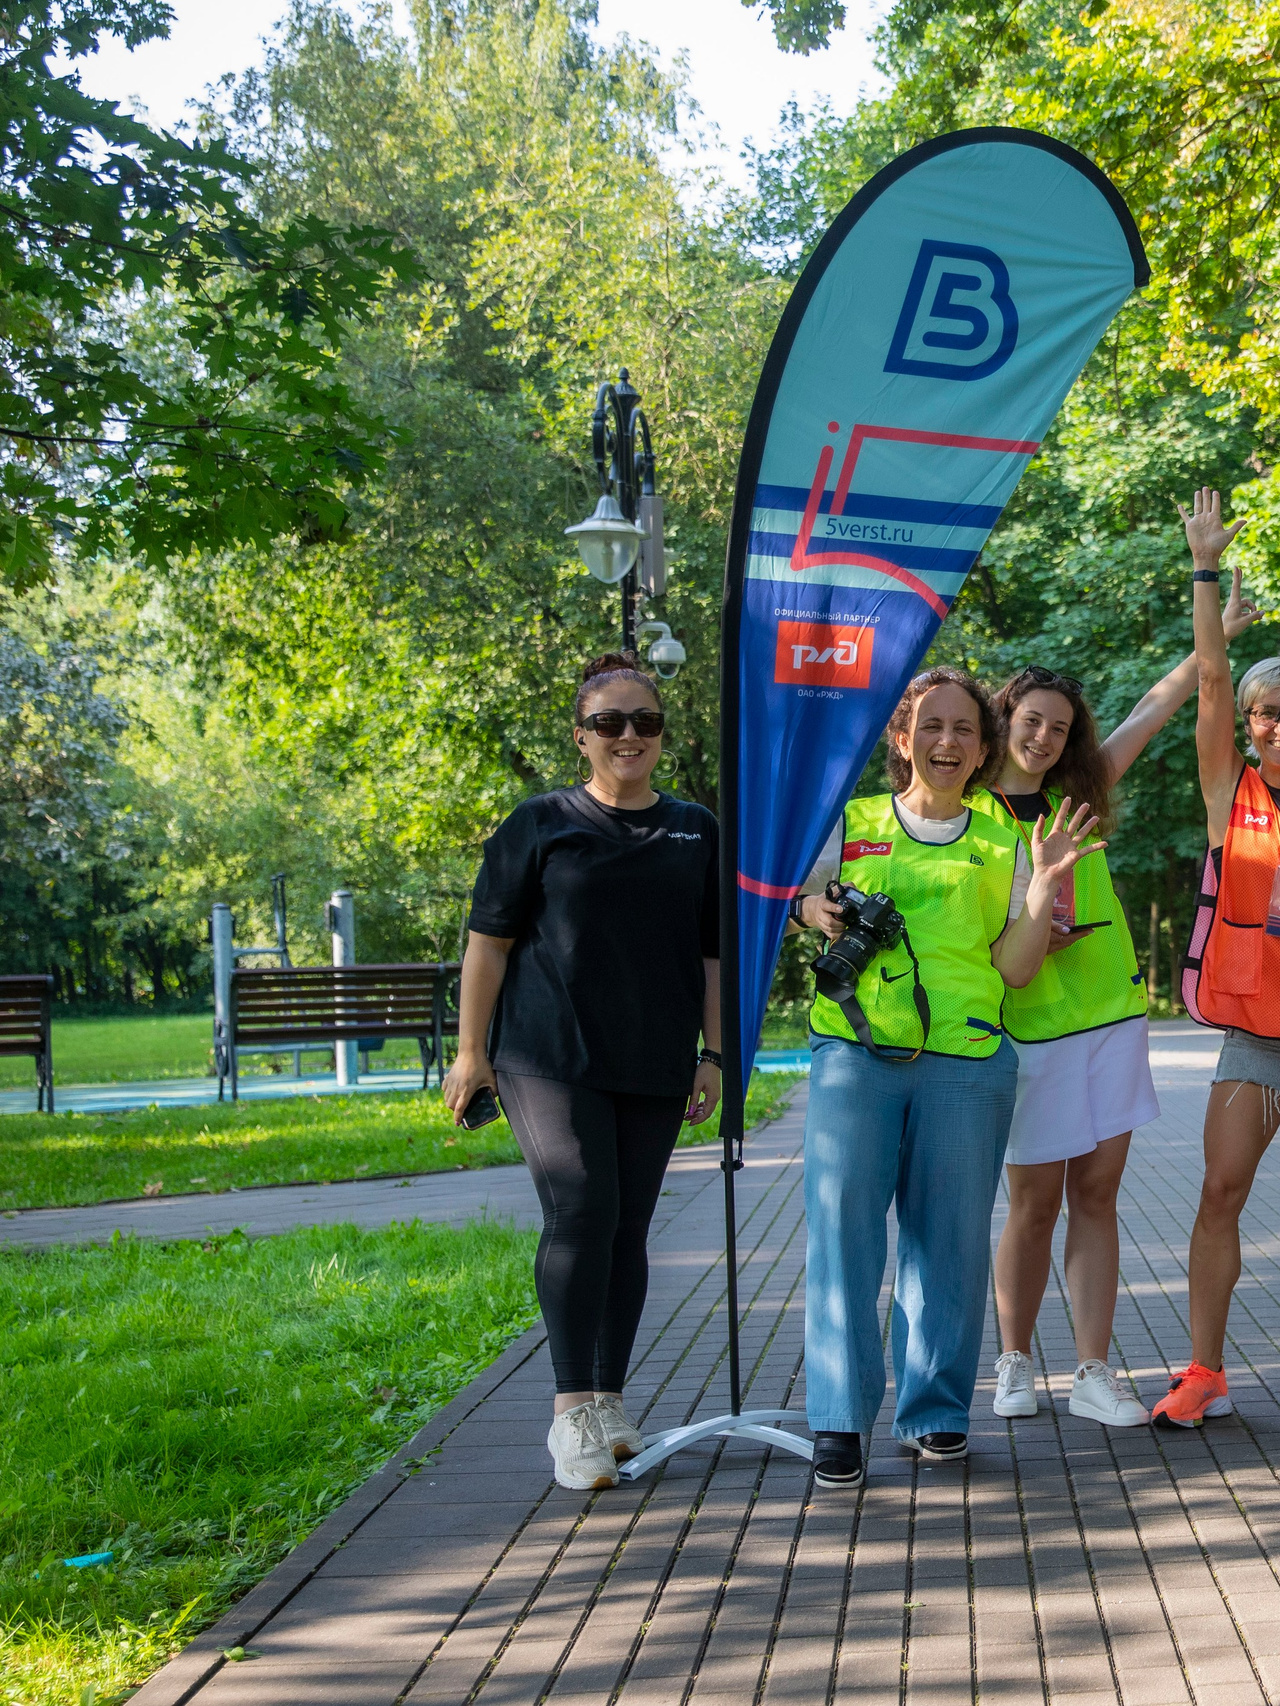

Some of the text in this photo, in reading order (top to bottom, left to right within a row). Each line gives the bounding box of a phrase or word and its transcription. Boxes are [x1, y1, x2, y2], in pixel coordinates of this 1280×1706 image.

[825, 518, 913, 543] 5verst.ru
[774, 608, 881, 624] ОФИЦИАЛЬНЫЙ ПАРТНЕР
[797, 689, 844, 700] ОАО «РЖД»
